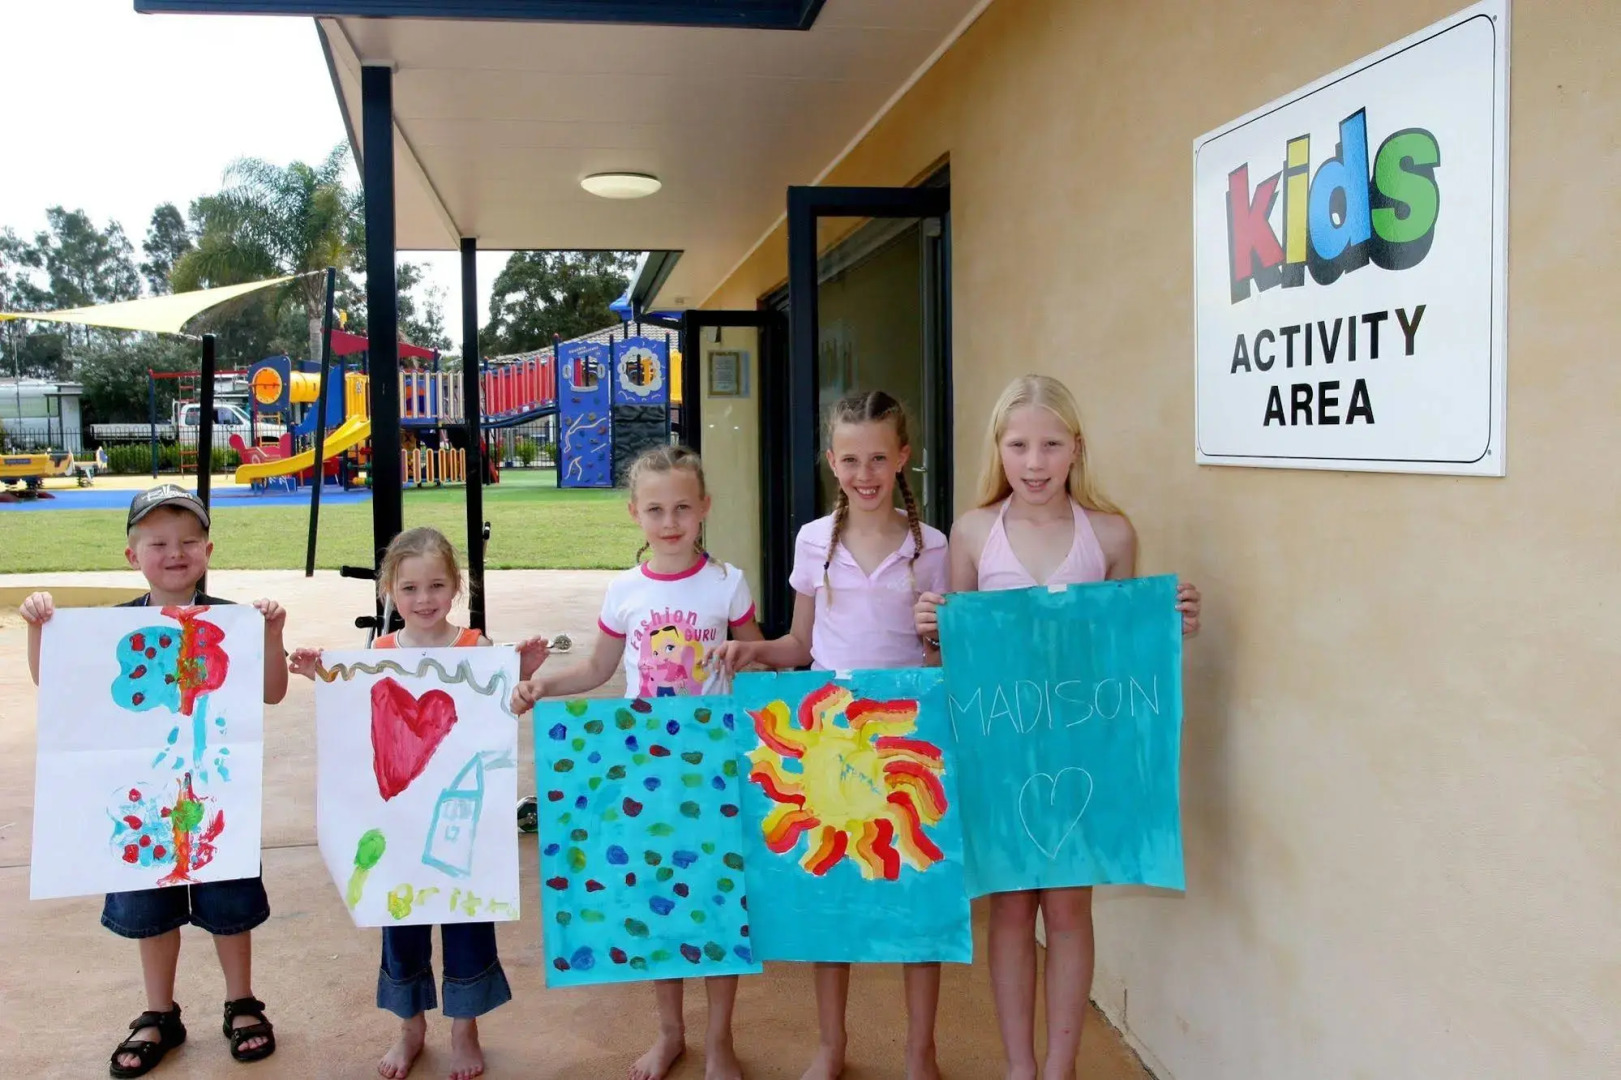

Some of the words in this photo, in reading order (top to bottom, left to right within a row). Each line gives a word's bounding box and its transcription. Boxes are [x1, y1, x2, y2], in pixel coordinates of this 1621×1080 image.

[1226, 106, 1440, 304] kids
[1230, 304, 1427, 374] ACTIVITY
[1263, 378, 1375, 426] AREA
[949, 675, 1159, 742] MADISON
